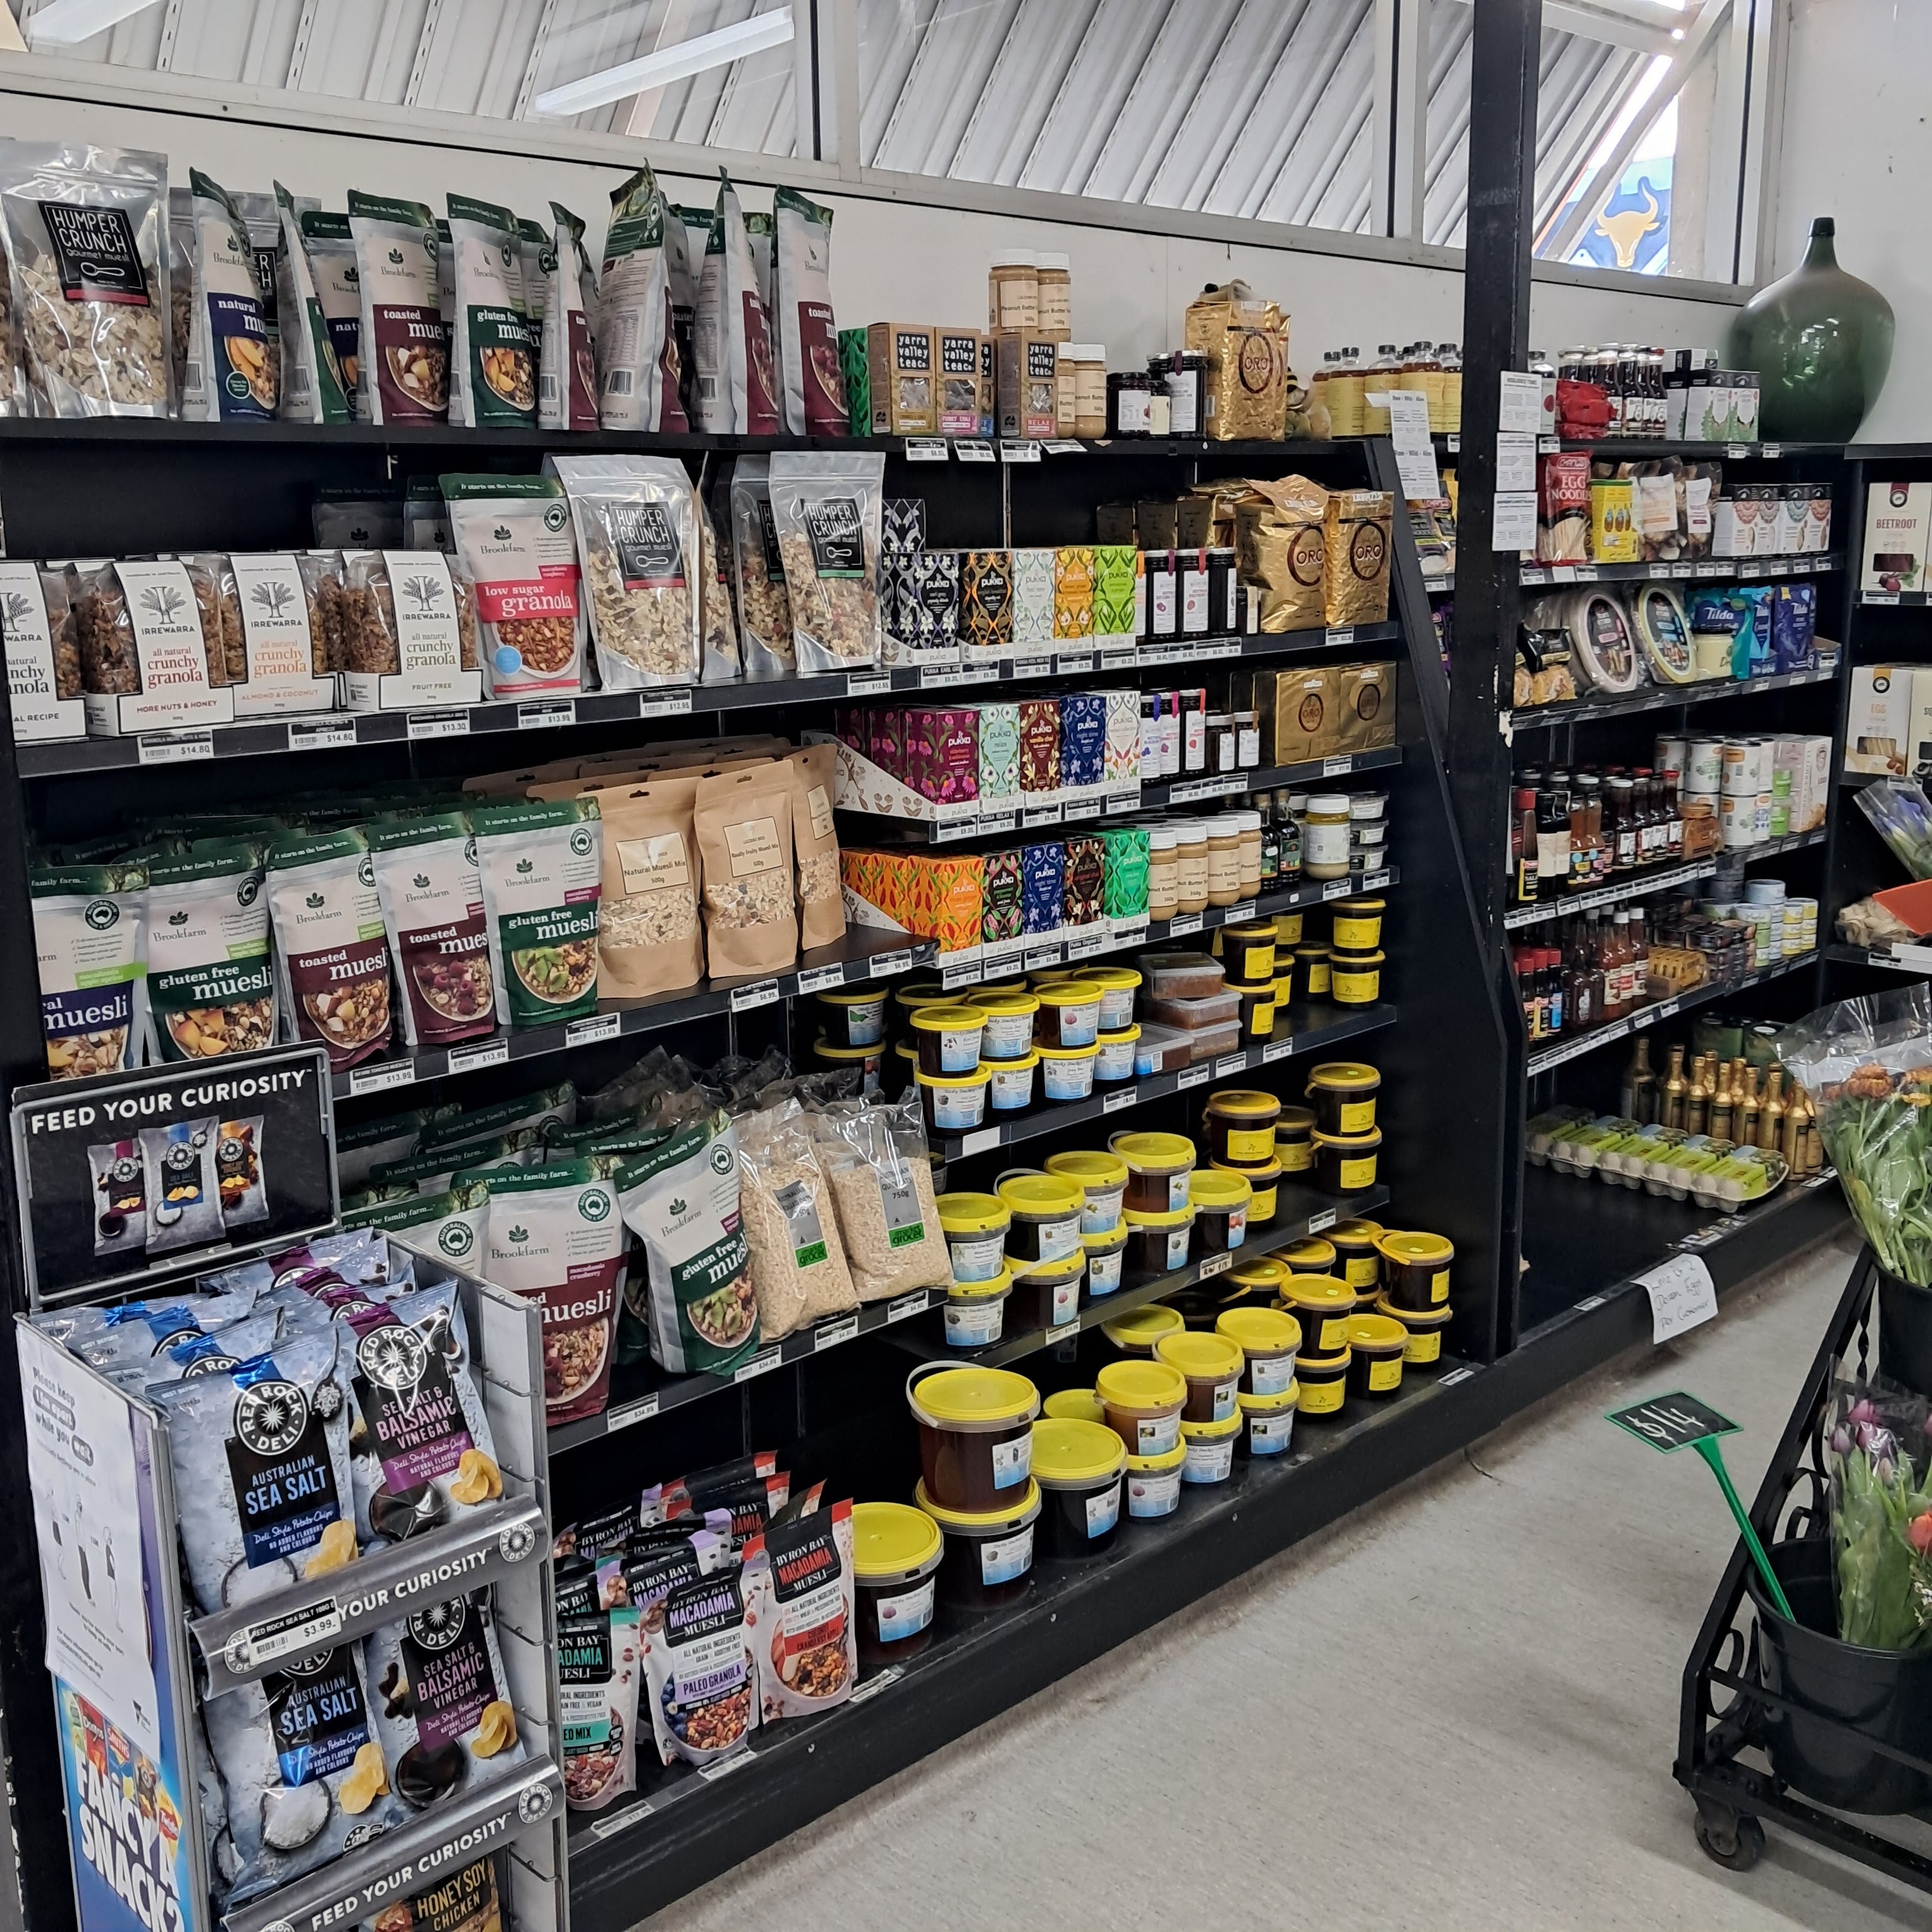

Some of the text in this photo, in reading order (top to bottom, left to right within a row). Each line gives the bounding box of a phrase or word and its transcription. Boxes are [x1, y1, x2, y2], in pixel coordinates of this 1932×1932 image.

[52, 211, 120, 235] HUMPER
[58, 228, 127, 252] CRUNCH
[66, 248, 101, 260] gourmet
[218, 298, 255, 313] natural
[384, 309, 421, 321] toasted
[477, 310, 504, 322] gluten
[898, 335, 927, 346] yarra
[945, 339, 973, 349] yarra
[898, 346, 928, 358] valley
[945, 350, 974, 362] valley
[1030, 345, 1053, 355] yarra
[1030, 355, 1053, 367] valley
[1244, 355, 1268, 372] ORO
[1562, 475, 1586, 489] EGG
[615, 509, 664, 527] HUMPER
[809, 504, 853, 522] HUMPER
[812, 520, 857, 537] CRUNCH
[1876, 518, 1917, 530] BEETROOT
[620, 526, 672, 544] CRUNCH
[1356, 544, 1381, 560] ORO
[981, 578, 1003, 588] pukka
[1108, 572, 1128, 580] pukka
[485, 585, 545, 597] low sugar
[926, 580, 950, 590] pukka
[501, 592, 573, 617] granola
[402, 613, 452, 621] IRREWARRA
[1704, 607, 1735, 620] Tilda
[141, 625, 196, 635] IRREWARRA
[250, 620, 303, 628] IRREWARRA
[164, 646, 191, 656] natural
[271, 639, 298, 648] natural
[407, 640, 454, 654] crunchy
[254, 647, 305, 663] crunchy
[406, 652, 457, 671] granola
[147, 656, 200, 671] crunchy
[254, 659, 307, 678] granola
[147, 668, 204, 690] granola
[279, 688, 319, 698] COCONUT
[137, 700, 217, 713] MORE NUTS HONEY
[669, 702, 690, 710] $12.95
[28, 712, 60, 722] RECIPE
[548, 714, 571, 723] $13.99
[1113, 716, 1133, 725] pukka
[1030, 725, 1052, 736] pukka
[1077, 721, 1098, 731] pukka
[948, 737, 971, 747] pukka
[989, 730, 1012, 740] pukka
[624, 859, 687, 877] Natural Muesli Mix
[1077, 862, 1097, 872] pukka
[1123, 855, 1142, 865] pukka
[504, 874, 551, 888] Brookfarm
[993, 876, 1014, 888] pukka
[1035, 869, 1056, 879] pukka
[405, 888, 450, 903] Brookfarm
[953, 884, 975, 895] pukka
[295, 909, 343, 924] Brookfarm
[508, 909, 572, 929] gluten free
[153, 927, 207, 942] Brookfarm
[536, 912, 599, 941] muesli
[409, 927, 458, 944] toasted
[299, 950, 348, 968] toasted
[895, 960, 910, 969] $6.99
[159, 965, 240, 989] gluten free
[192, 965, 273, 1001] muesli
[44, 994, 128, 1030] muesli
[594, 1027, 617, 1037] $13.99
[482, 1051, 506, 1062] $13.99
[386, 1071, 412, 1083] $13.99
[31, 1070, 307, 1135] FEED YOUR CURIOSITY
[523, 1171, 547, 1183] family
[892, 1190, 910, 1200] 750g
[383, 1212, 408, 1224] family
[661, 1209, 702, 1238] Brookfarm
[892, 1228, 922, 1246] grocer
[491, 1245, 549, 1260] Brookfarm
[682, 1240, 738, 1281] gluten free
[570, 1264, 606, 1274] macadamia
[570, 1269, 601, 1281] cranberry
[32, 1366, 75, 1409] Please keep
[51, 1402, 73, 1428] apart
[376, 1394, 456, 1442] BALSAMIC
[1625, 1403, 1705, 1445] $14
[35, 1412, 91, 1462] while you wait
[255, 1424, 302, 1452] DELI
[396, 1419, 451, 1450] VINEGAR
[409, 1443, 449, 1465] Style Potato
[252, 1455, 315, 1488] AUSTRALIAN
[245, 1465, 327, 1515] SEA SALT
[253, 1517, 313, 1545] Deli Style Potato
[776, 1536, 827, 1566] BYRON BAY
[778, 1553, 833, 1586] MACADAMIA
[338, 1549, 489, 1622] YOUR CURIOSITY
[633, 1563, 690, 1593] BYRON BAY
[793, 1569, 828, 1593] MUESLI
[669, 1591, 736, 1629] MACADAMIA
[266, 1610, 314, 1632] ROCK SEA SALT
[303, 1619, 333, 1638] $3.99
[683, 1613, 726, 1637] MUESLI
[425, 1621, 461, 1648] DELI
[577, 1635, 599, 1647] BAY
[424, 1648, 465, 1676] SEA SALT
[417, 1652, 484, 1703] BALSAMIC
[683, 1664, 742, 1696] PALEO GRANOLA
[288, 1675, 347, 1709] AUSTRALIAN
[433, 1677, 479, 1710] VINEGAR
[280, 1687, 358, 1736] SEA SALT
[576, 1727, 592, 1739] MIX
[75, 1745, 152, 1870] FANCY
[159, 1831, 181, 1901] A
[310, 1813, 508, 1932] FEED YOUR CURIOSITY
[417, 1856, 491, 1918] HONEY SOY
[433, 1892, 481, 1932] CHICKEN
